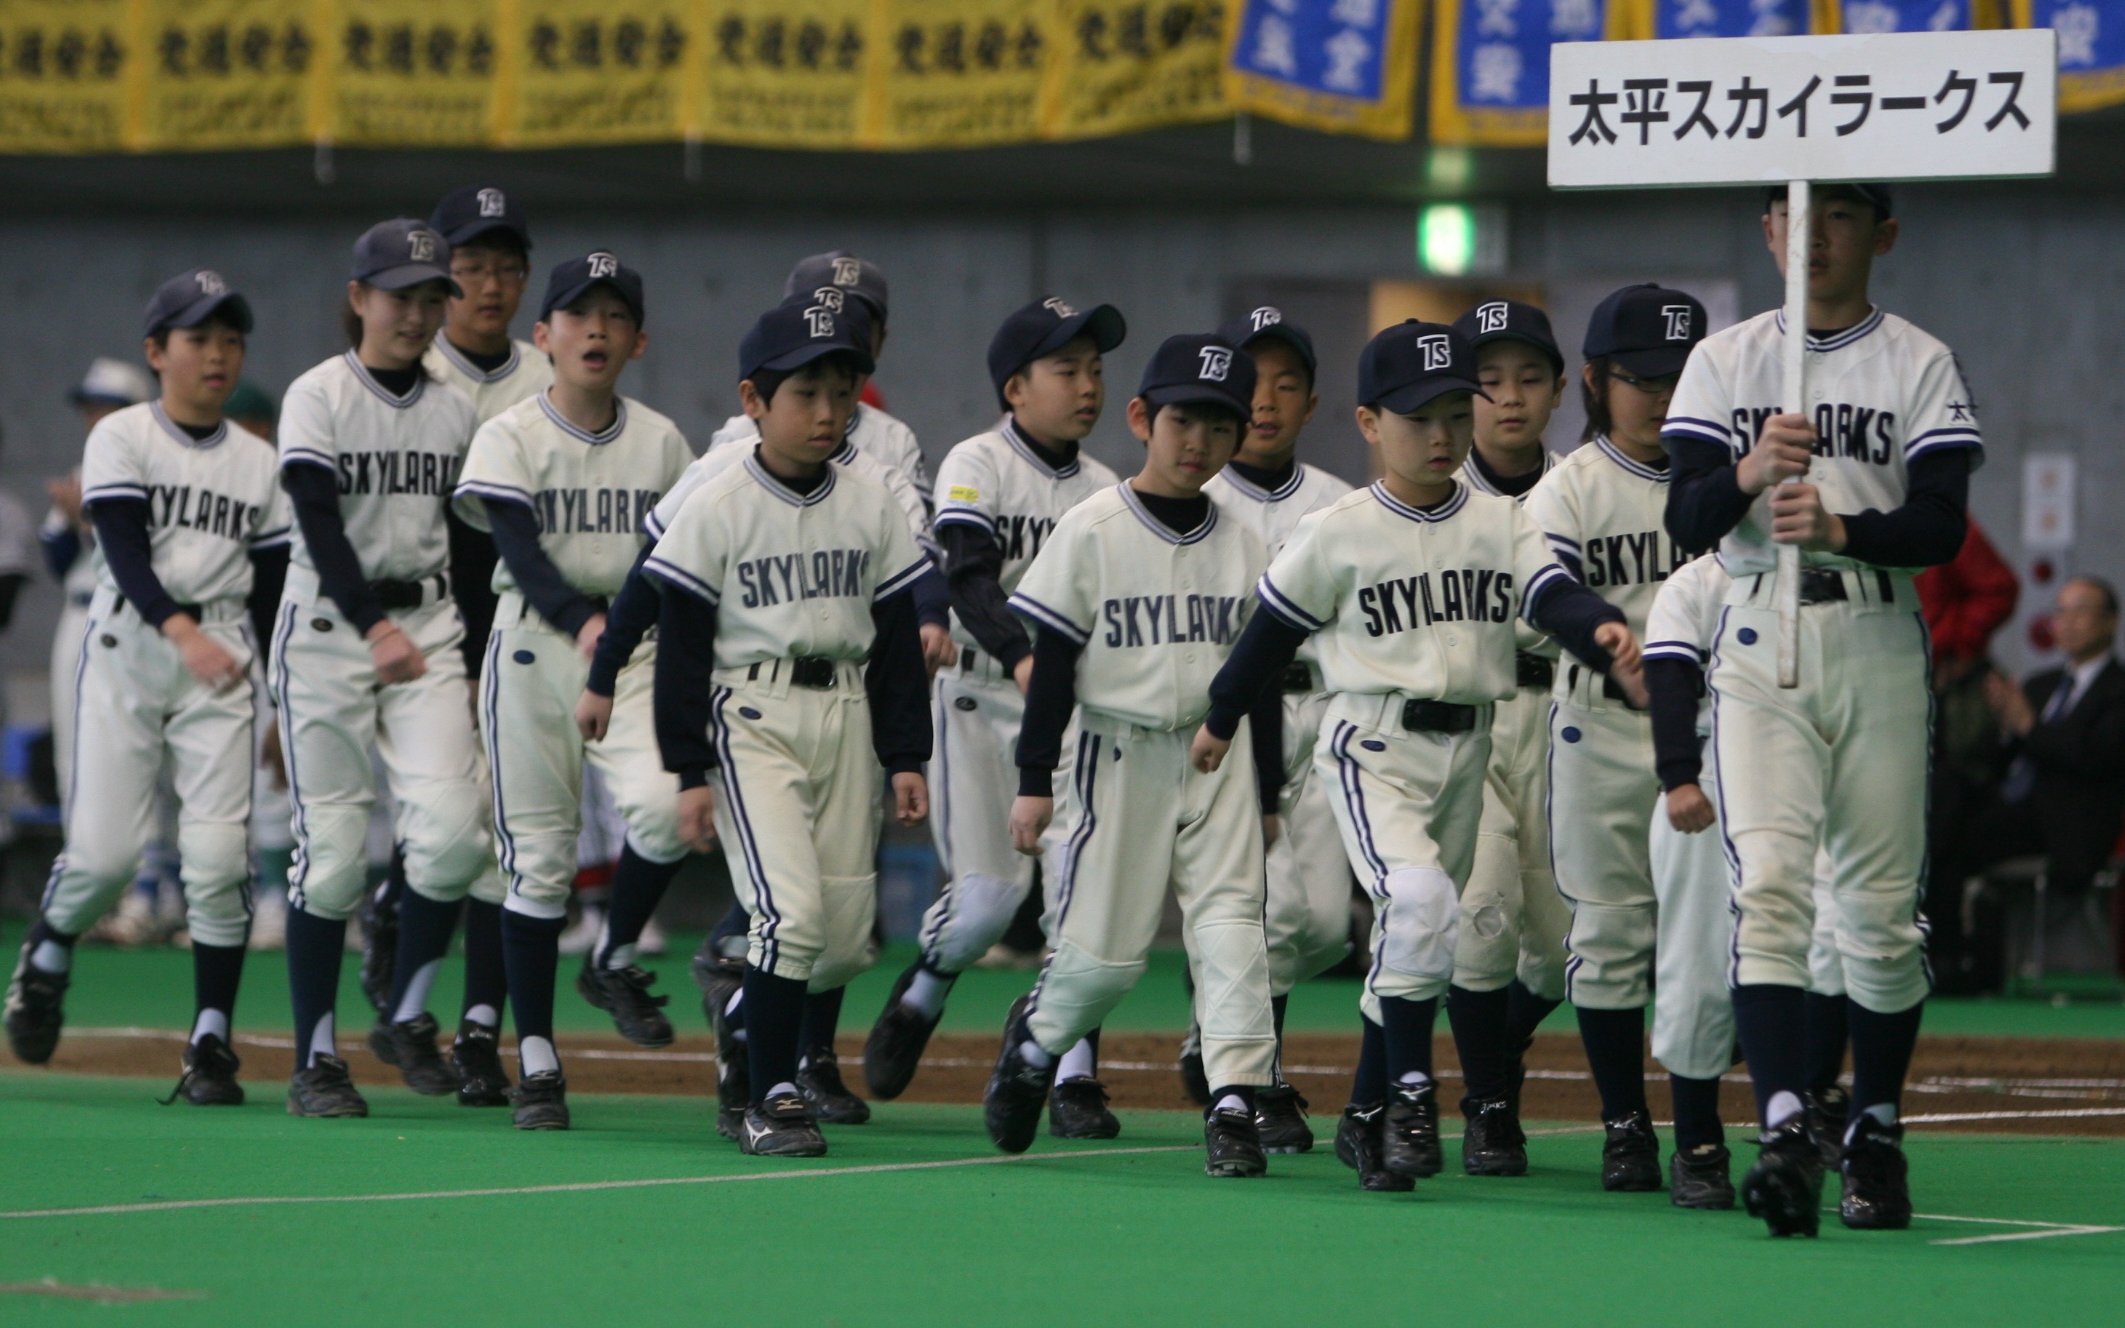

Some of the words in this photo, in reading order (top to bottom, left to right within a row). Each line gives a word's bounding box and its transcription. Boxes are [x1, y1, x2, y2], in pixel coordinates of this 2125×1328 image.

[1568, 69, 2031, 147] 太平スカイラークス
[1476, 301, 1508, 334] TS
[1661, 304, 1692, 341] TS
[1198, 345, 1234, 383] TS
[1417, 333, 1452, 372] TS
[1732, 403, 1895, 466] SKARKS
[1358, 569, 1513, 638] SKYLARKS
